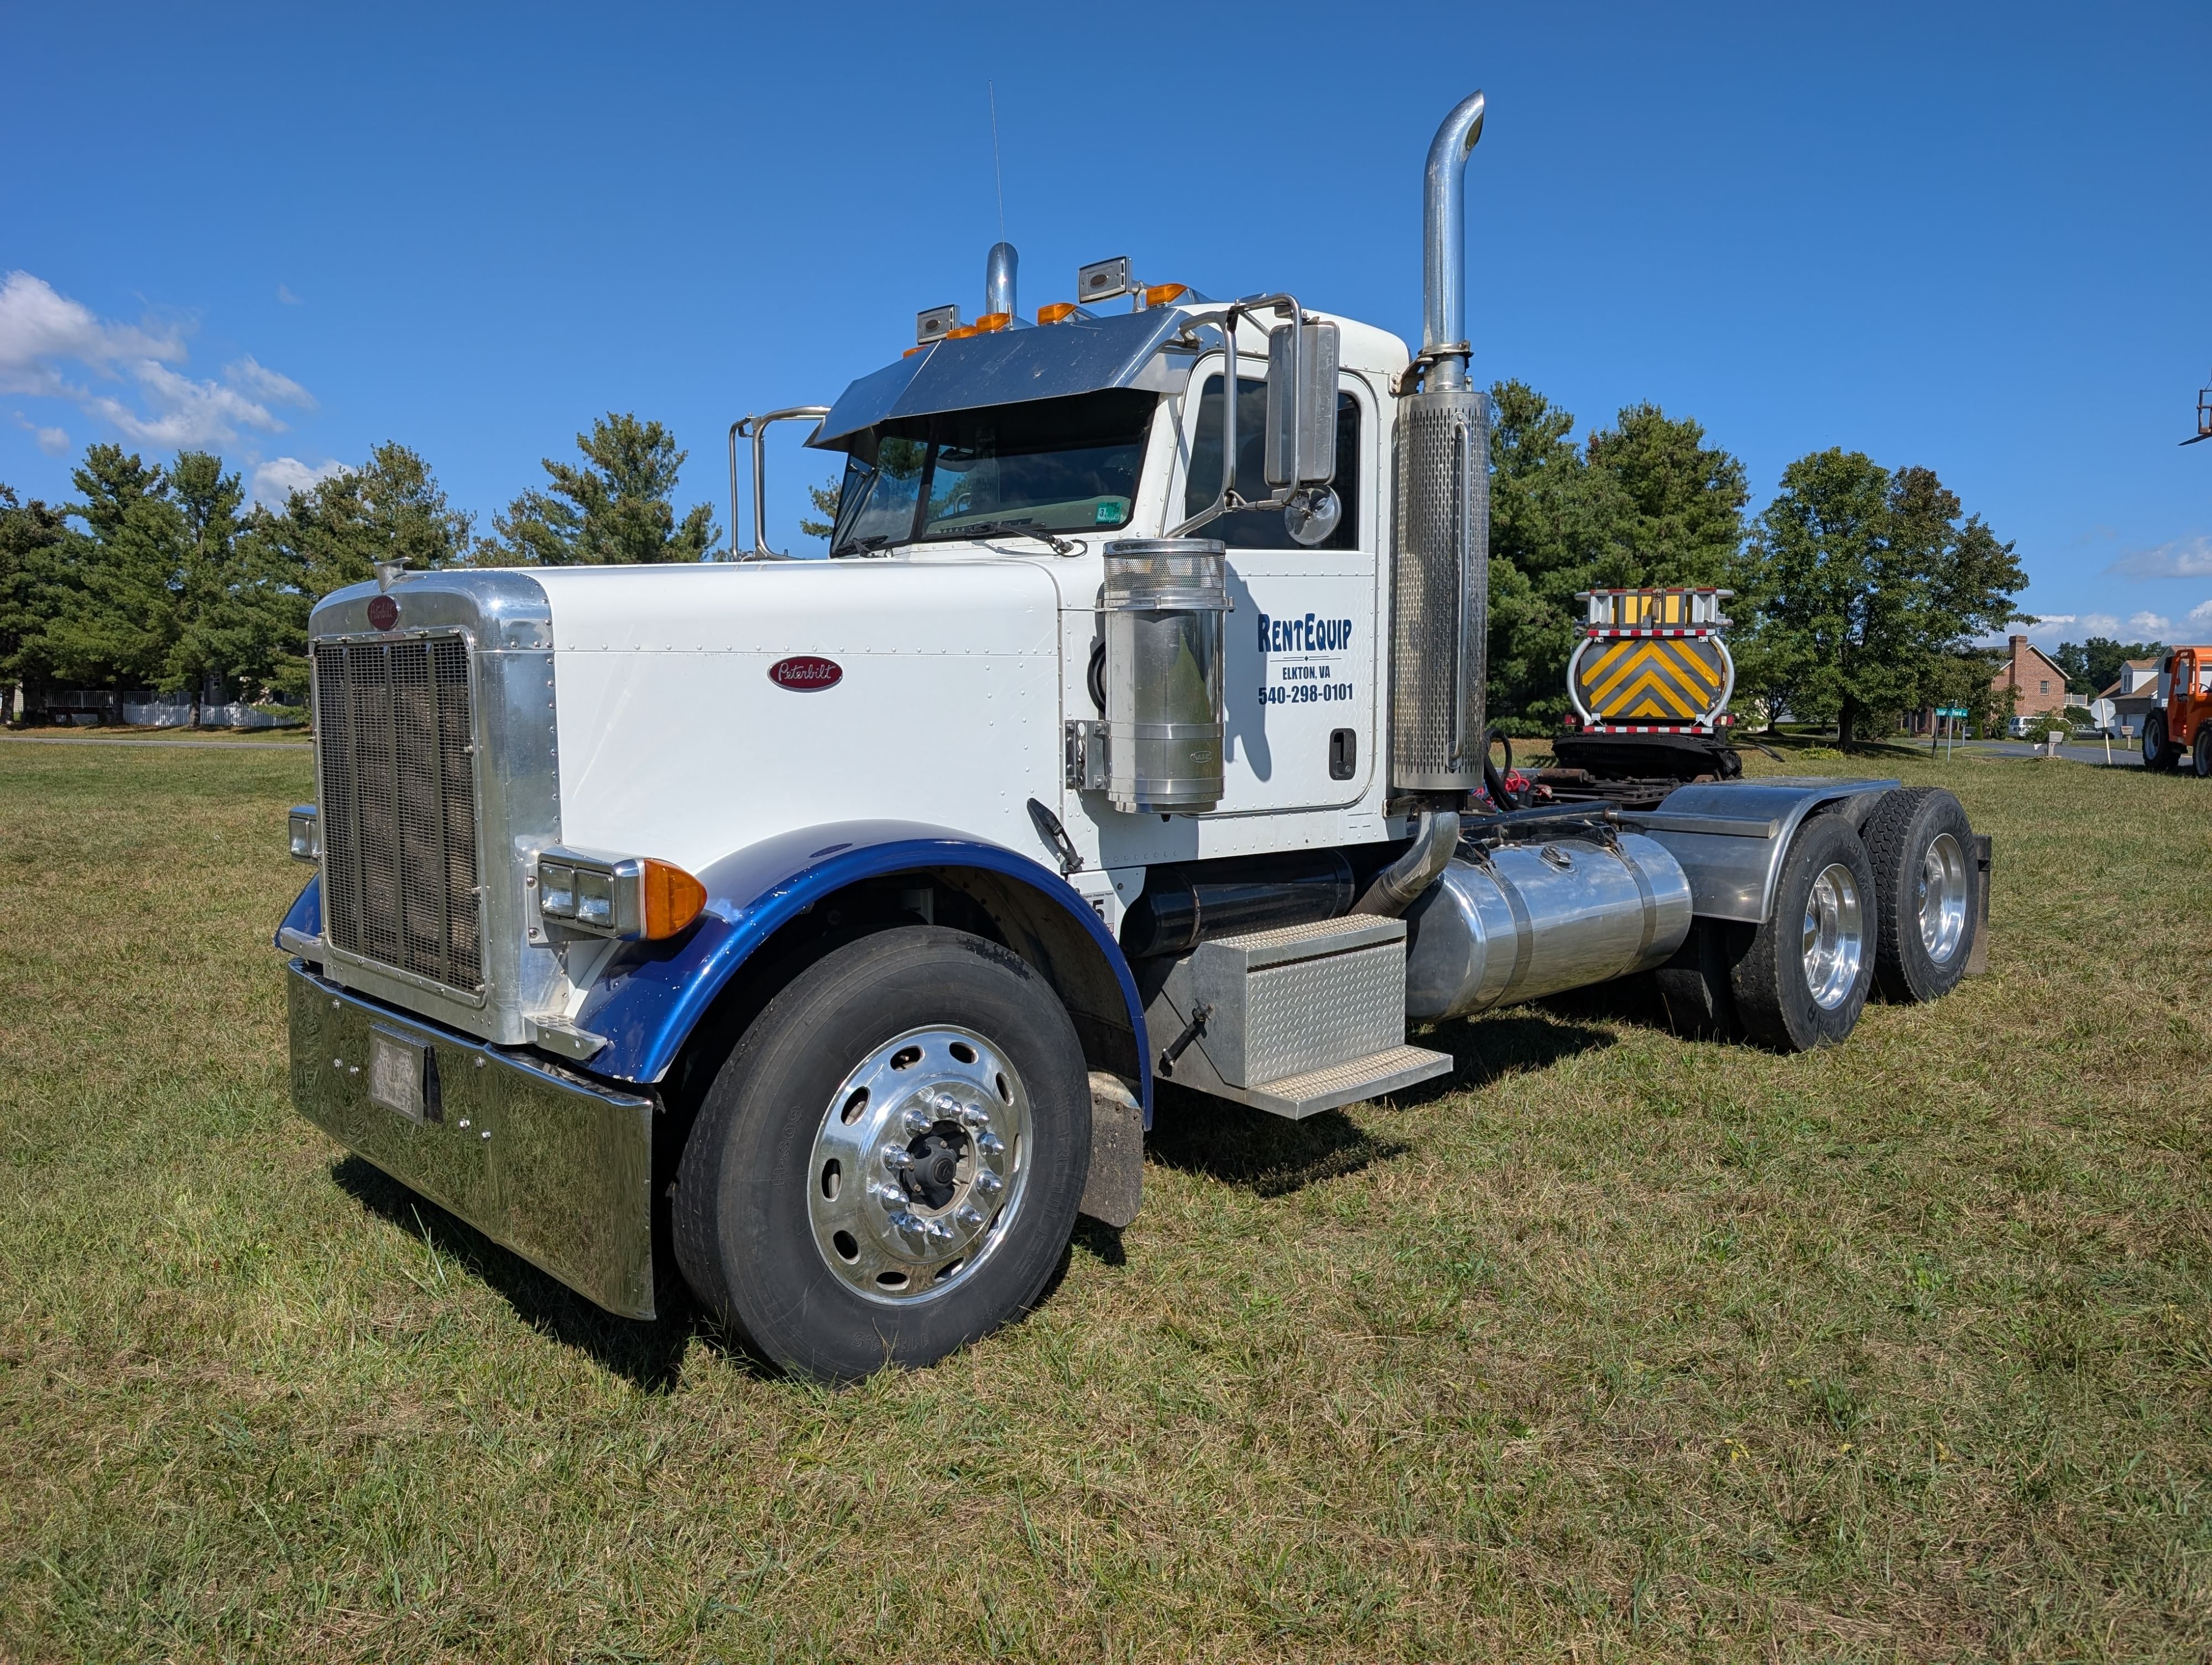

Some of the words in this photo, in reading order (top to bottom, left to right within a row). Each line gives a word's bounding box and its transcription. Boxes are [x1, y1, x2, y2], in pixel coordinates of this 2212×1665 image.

[778, 662, 836, 681] Peterbilt
[1282, 666, 1317, 680] ELKTON,
[1319, 665, 1331, 678] VA
[1258, 683, 1353, 705] 540-298-0101
[770, 1106, 802, 1186] H-309
